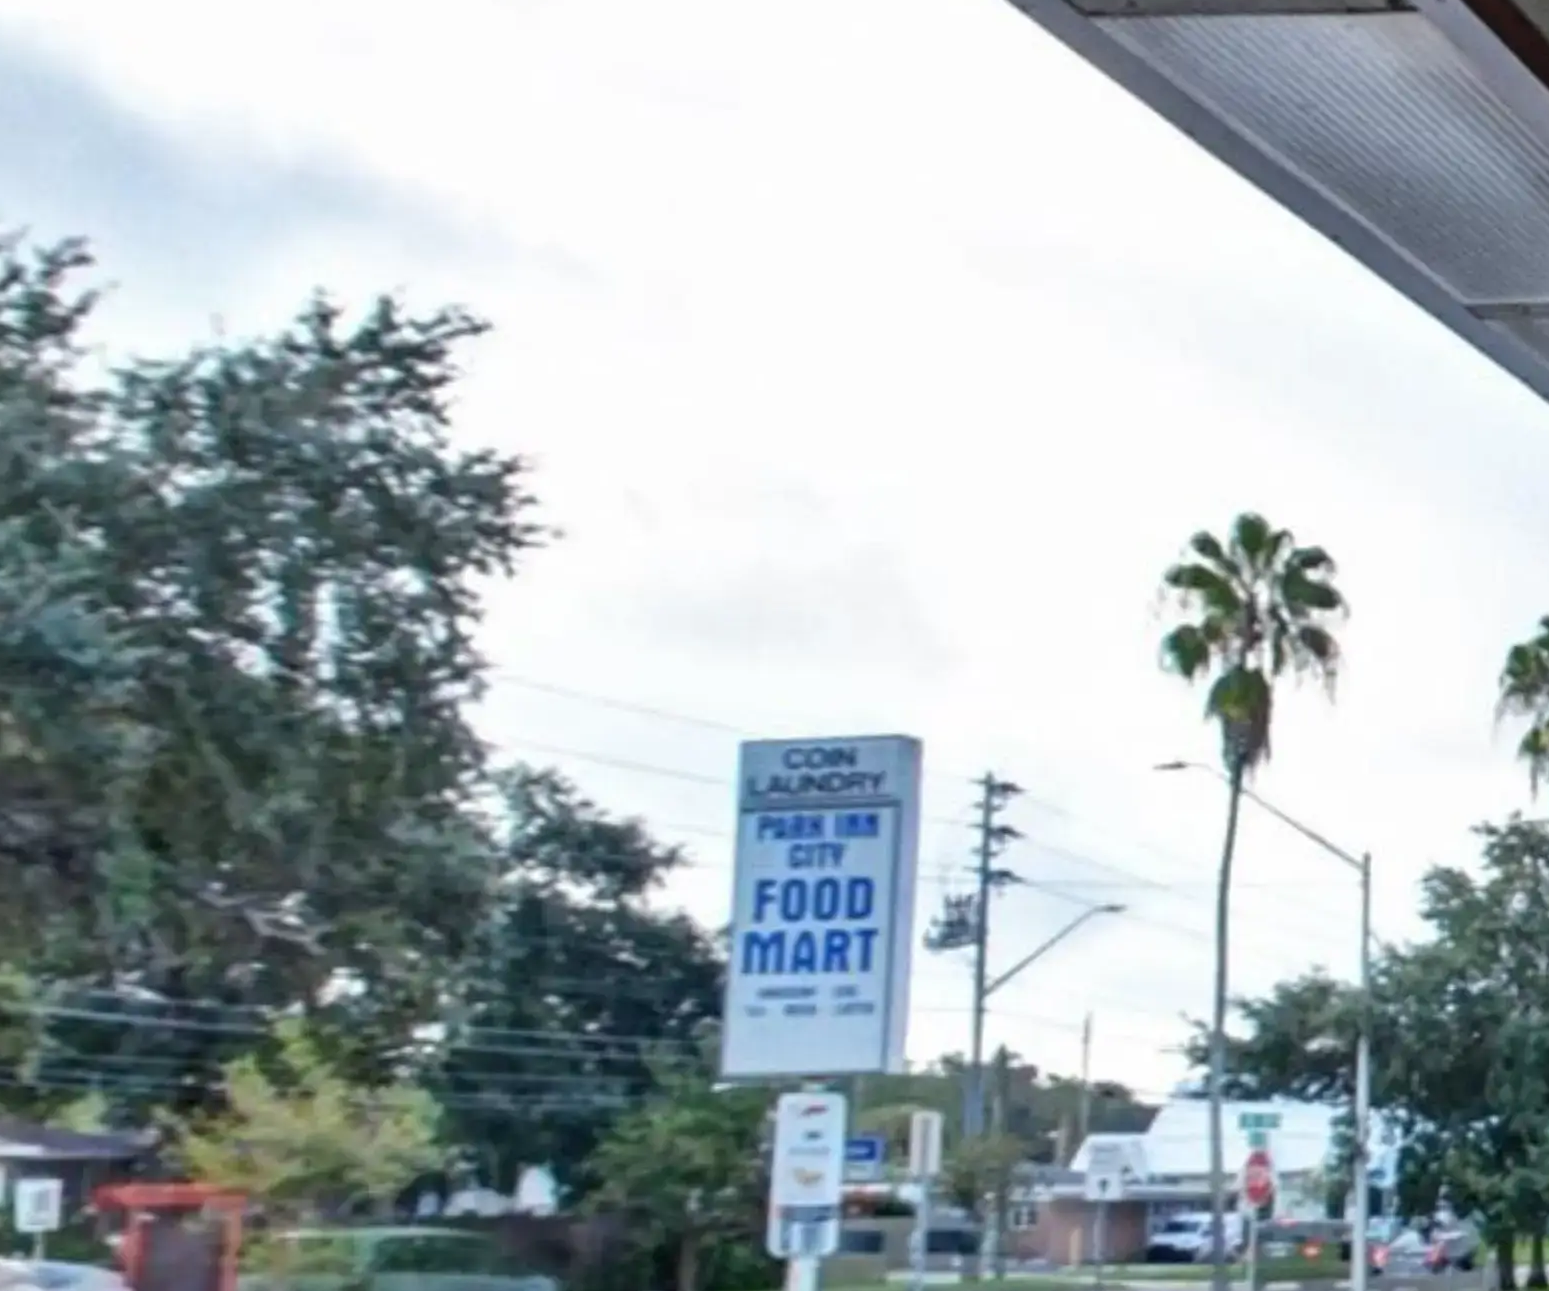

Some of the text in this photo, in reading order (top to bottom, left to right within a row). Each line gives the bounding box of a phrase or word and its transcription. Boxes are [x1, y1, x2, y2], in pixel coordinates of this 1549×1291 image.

[782, 747, 857, 770] COIN
[746, 771, 887, 796] LAUNDRY
[753, 876, 875, 924] FOOD
[741, 927, 879, 975] MART
